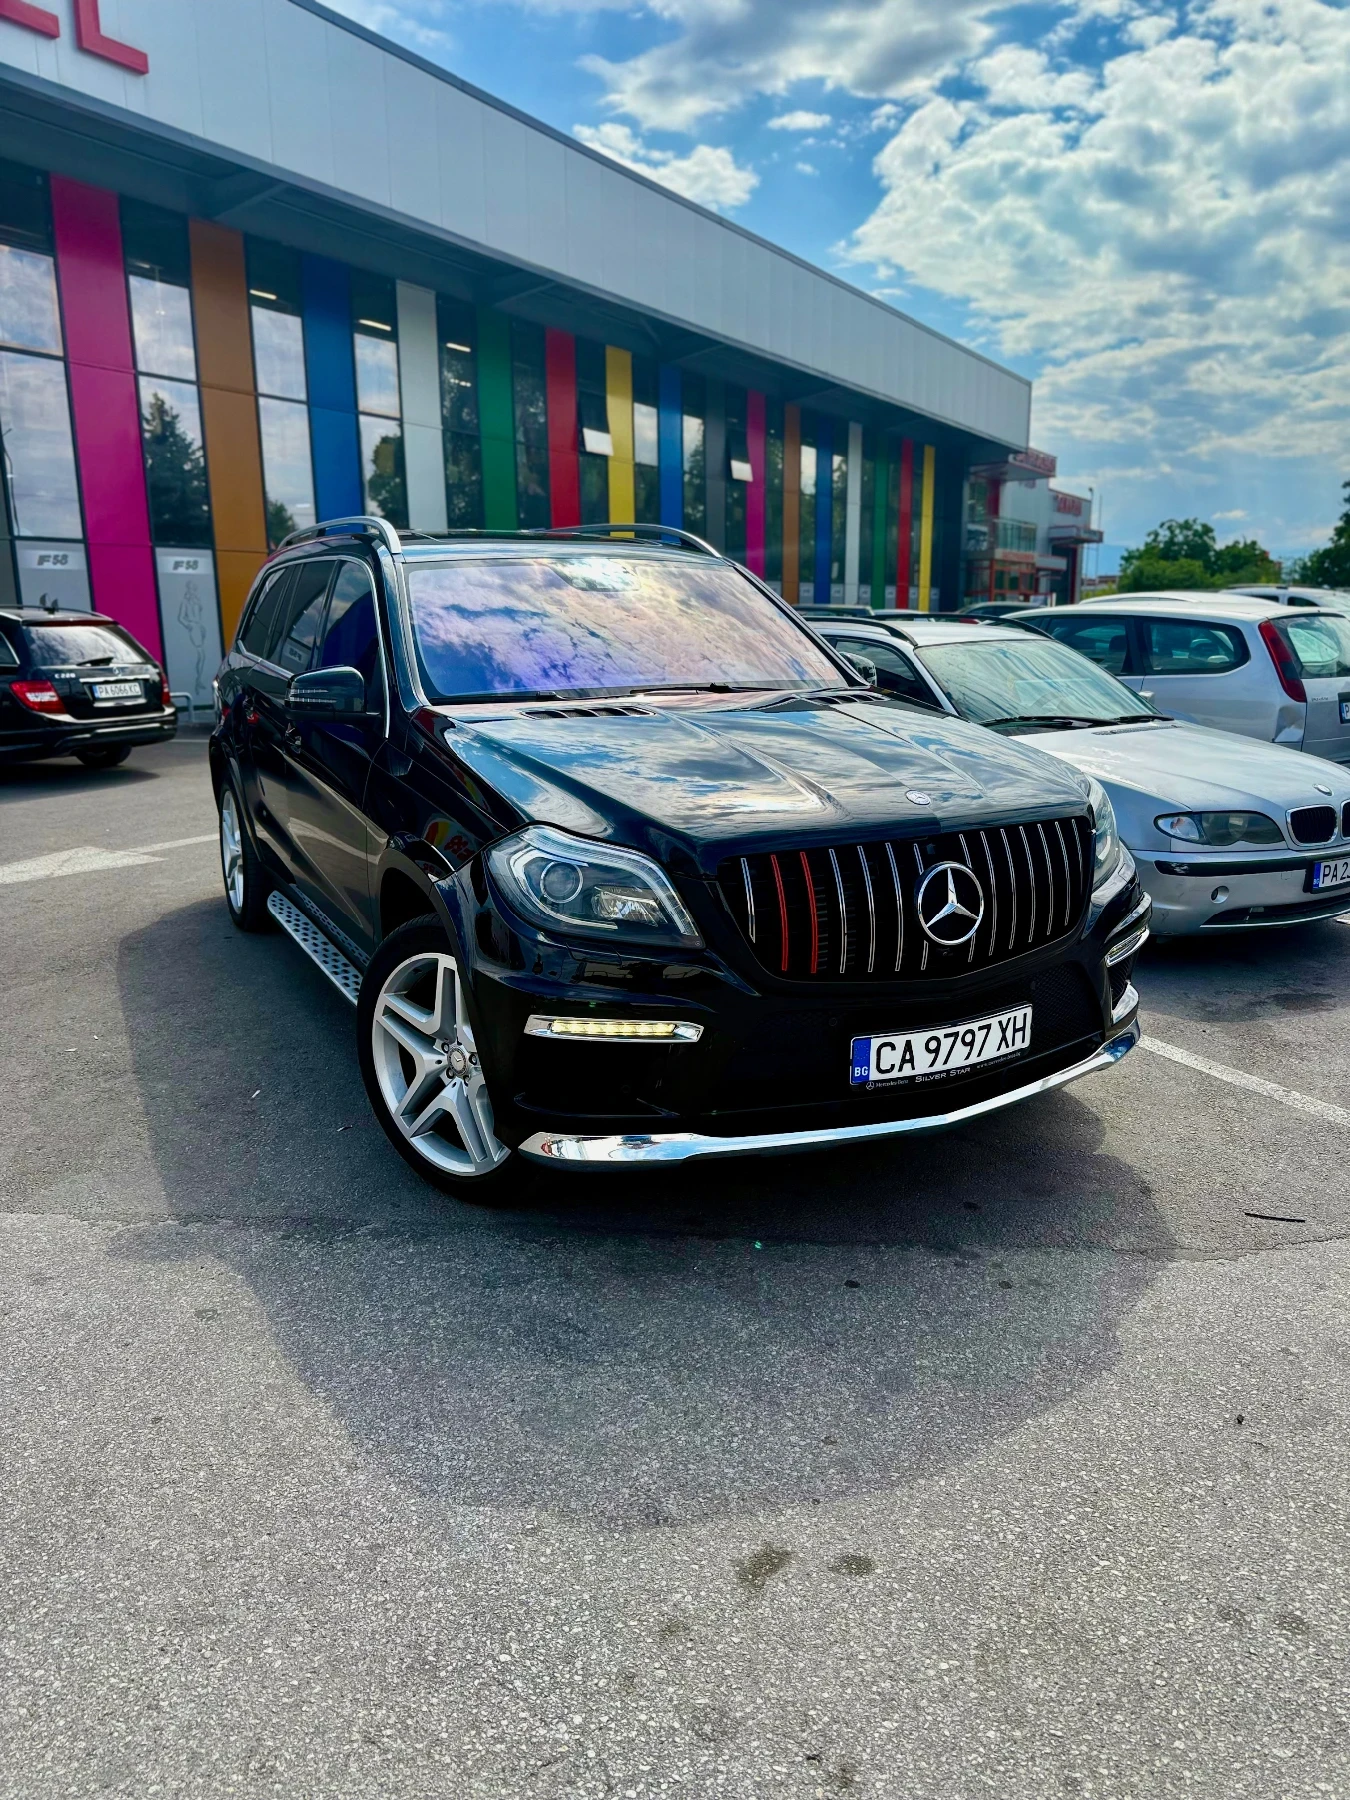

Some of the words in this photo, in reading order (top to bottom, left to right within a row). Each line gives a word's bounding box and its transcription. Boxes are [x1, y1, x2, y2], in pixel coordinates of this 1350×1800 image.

[1321, 863, 1338, 884] PA
[1340, 861, 1350, 880] 2
[875, 1039, 915, 1075] CA
[924, 1023, 992, 1068] 9797
[996, 1012, 1028, 1052] XH
[854, 1066, 869, 1077] BG
